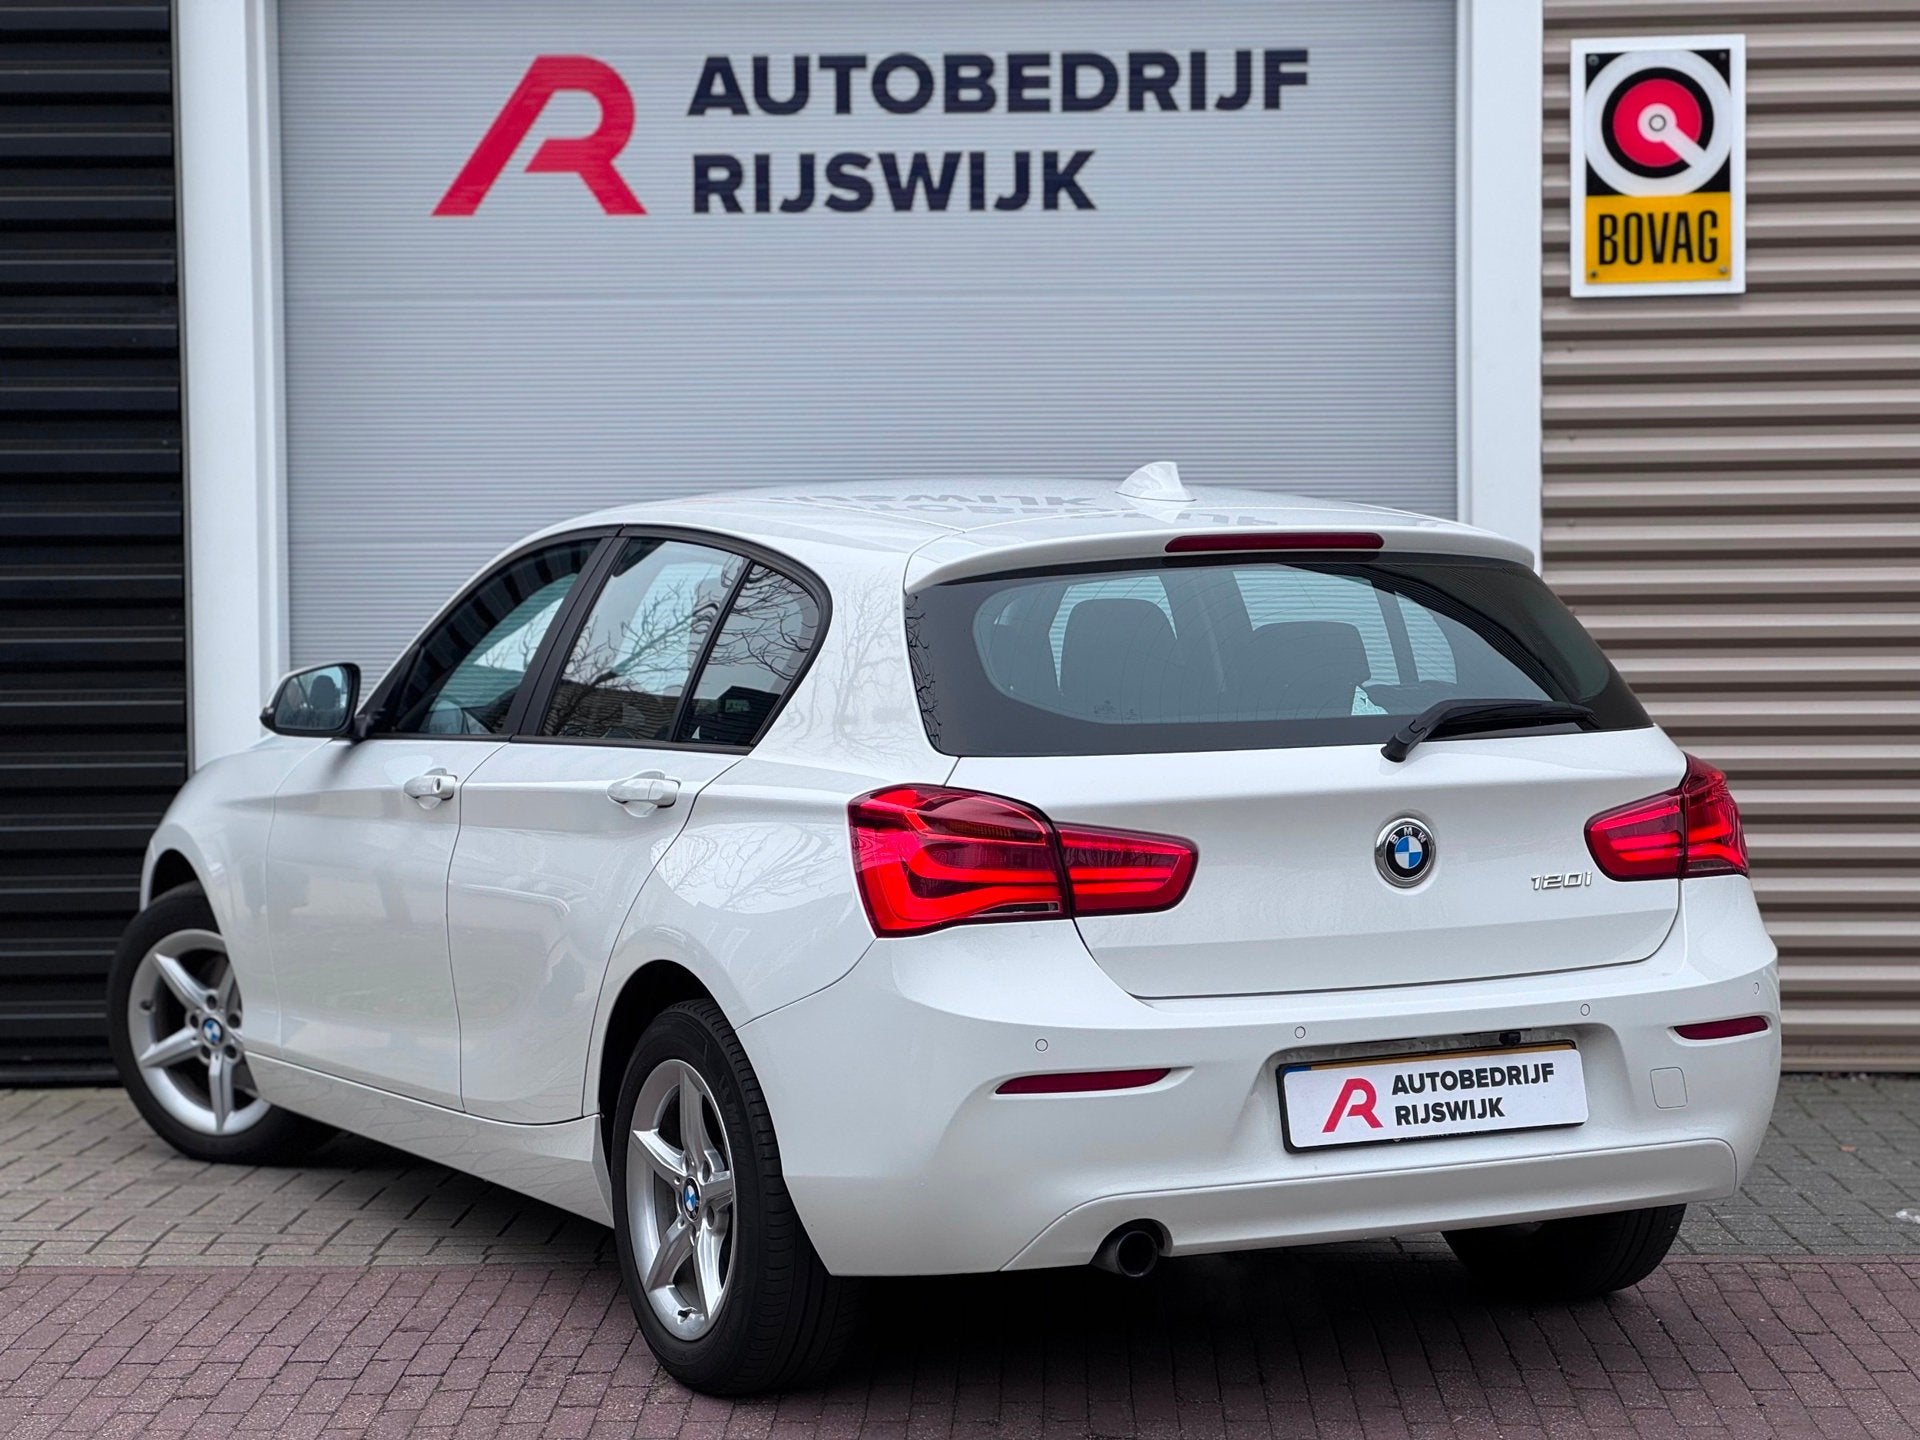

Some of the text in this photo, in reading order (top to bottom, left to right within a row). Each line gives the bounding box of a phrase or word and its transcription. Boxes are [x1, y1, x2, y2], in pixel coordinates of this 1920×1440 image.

[687, 49, 1309, 116] AUTOBEDRIJF
[692, 150, 1096, 214] RIJSWIJK
[1598, 209, 1718, 266] BOVAG
[1389, 827, 1427, 845] BMW
[1531, 871, 1593, 891] 120i
[1392, 1062, 1555, 1096] AUTOBEDRIJF
[1395, 1096, 1506, 1127] RIJSWIJK
